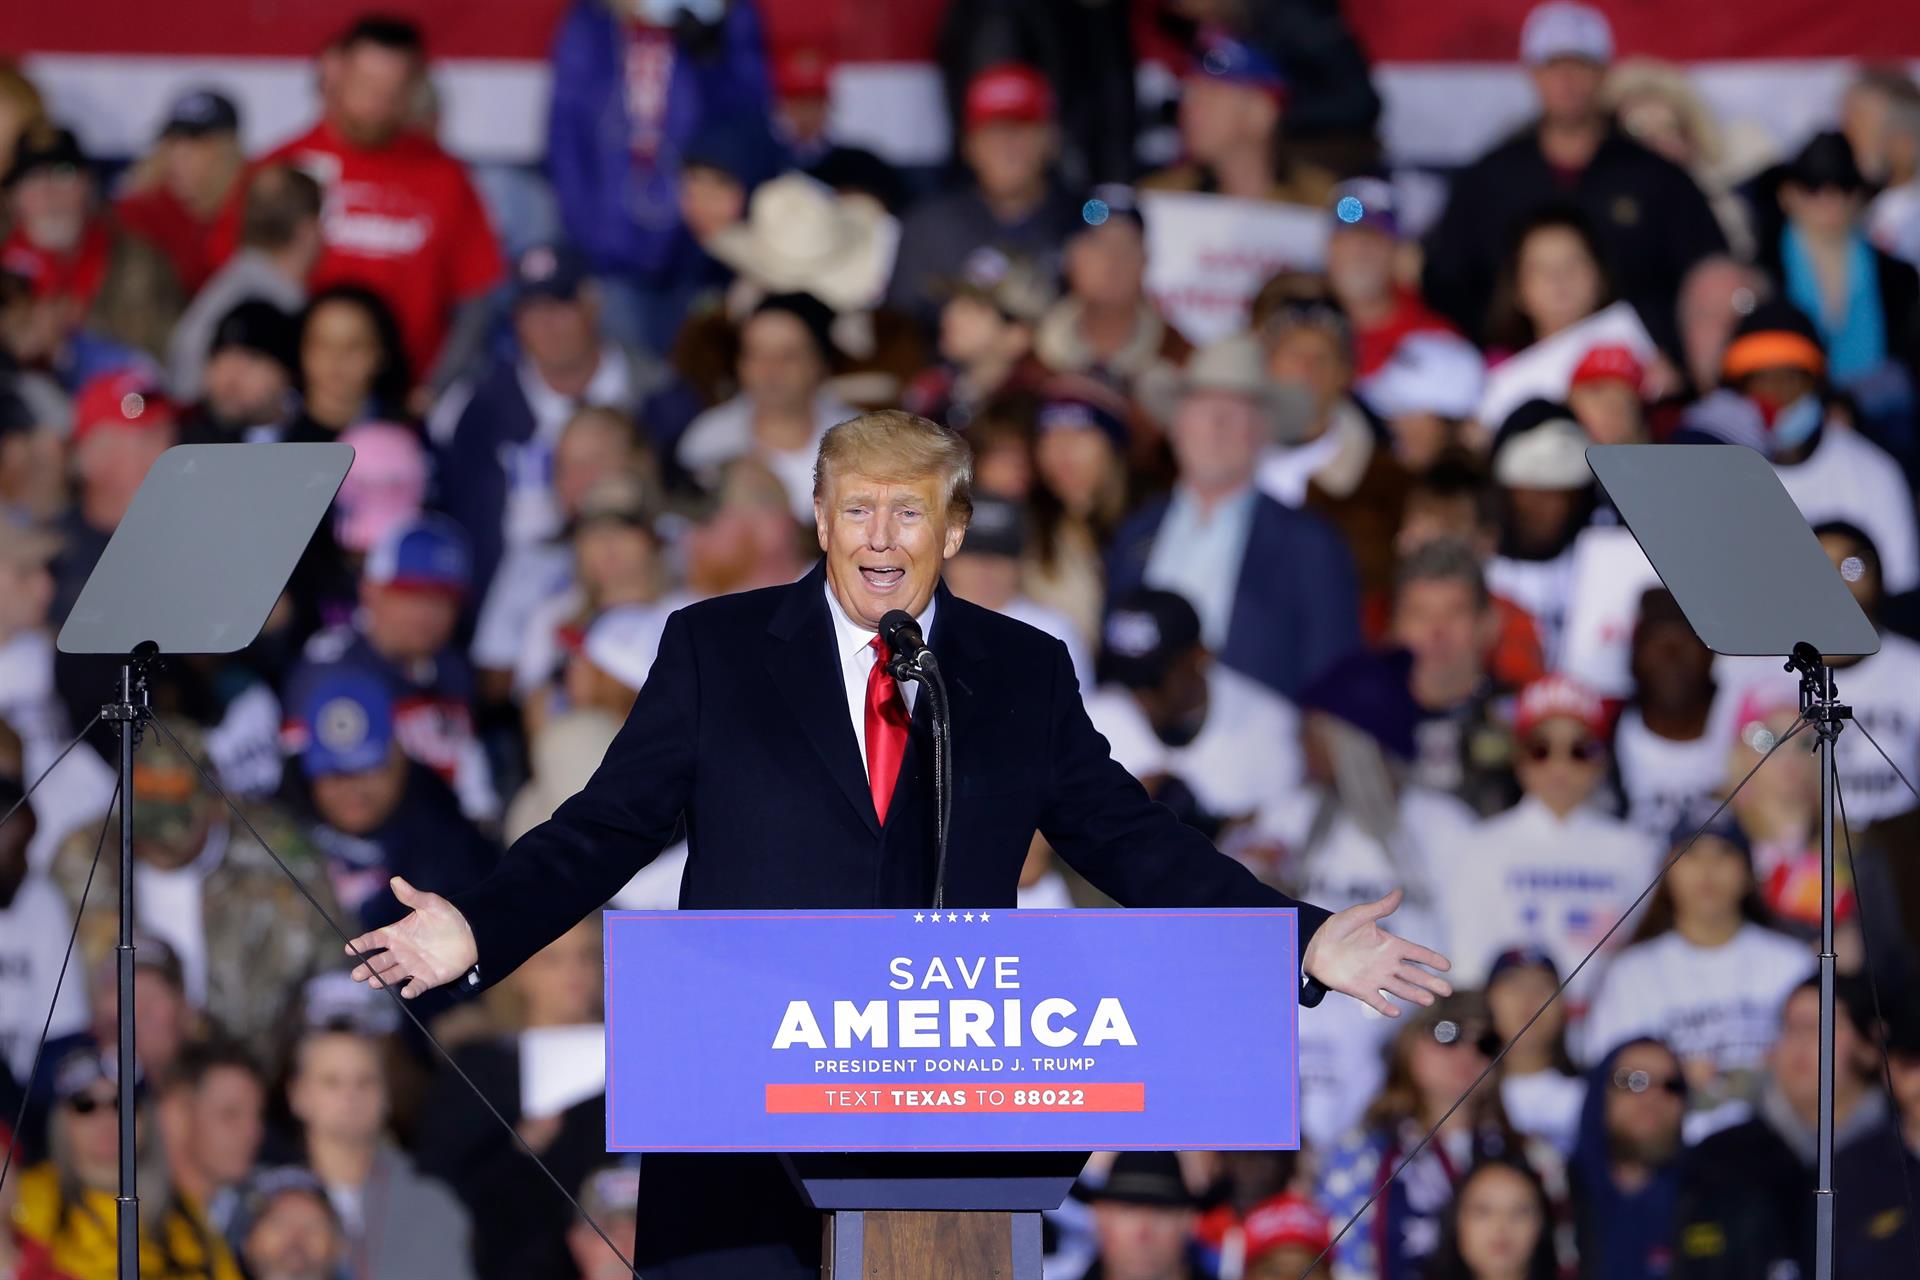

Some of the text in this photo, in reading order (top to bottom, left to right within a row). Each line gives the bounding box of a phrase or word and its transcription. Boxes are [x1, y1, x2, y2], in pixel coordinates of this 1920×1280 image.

[888, 956, 1020, 990] SAVE
[771, 997, 1138, 1050] AMERICA
[814, 1057, 1095, 1073] PRESIDENT DONALD J. TRUMP
[824, 1089, 1085, 1107] TEXT TEXAS TO 88022
